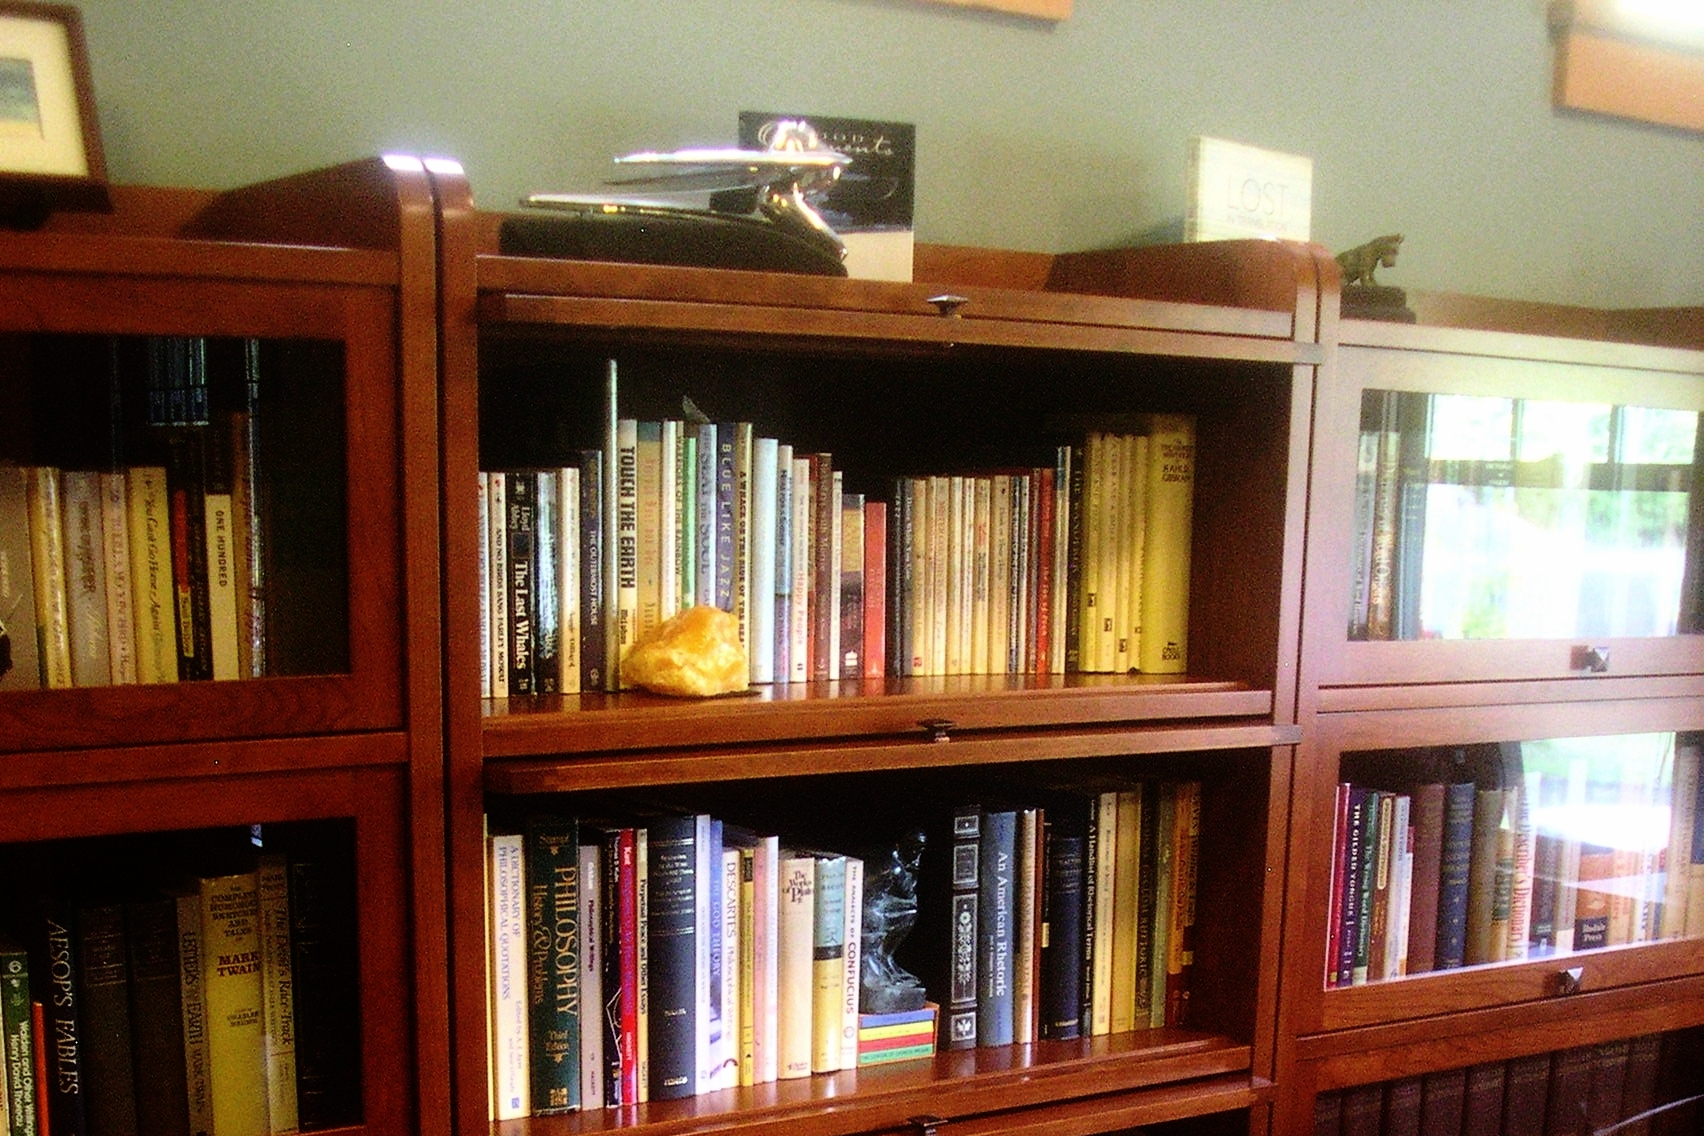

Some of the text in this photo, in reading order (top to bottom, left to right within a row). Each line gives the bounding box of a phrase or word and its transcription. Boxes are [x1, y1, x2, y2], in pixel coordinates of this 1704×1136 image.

[1227, 175, 1289, 216] LOST
[215, 510, 228, 588] ONE HUNDRED
[621, 447, 635, 589] TOUCH THE EARTH
[719, 443, 731, 598] BLUE LIKE JAZZ
[515, 561, 529, 670] The Last Whales
[795, 573, 805, 607] Happy
[499, 847, 511, 1001] PHILOSOPHICAL QUOTATIONS
[511, 855, 521, 921] DICTIONARY
[726, 861, 737, 938] DESCARTES
[996, 852, 1009, 997] An American Rhetoric
[1510, 887, 1529, 943] Dictionary
[216, 963, 261, 977] TWAIN
[218, 951, 259, 966] MARK
[531, 884, 553, 1004] History & Problems
[555, 867, 579, 1017] PHILOSOPHY
[846, 941, 857, 1015] CONFUCIUS
[48, 920, 79, 1095] AESOP'S FABLES
